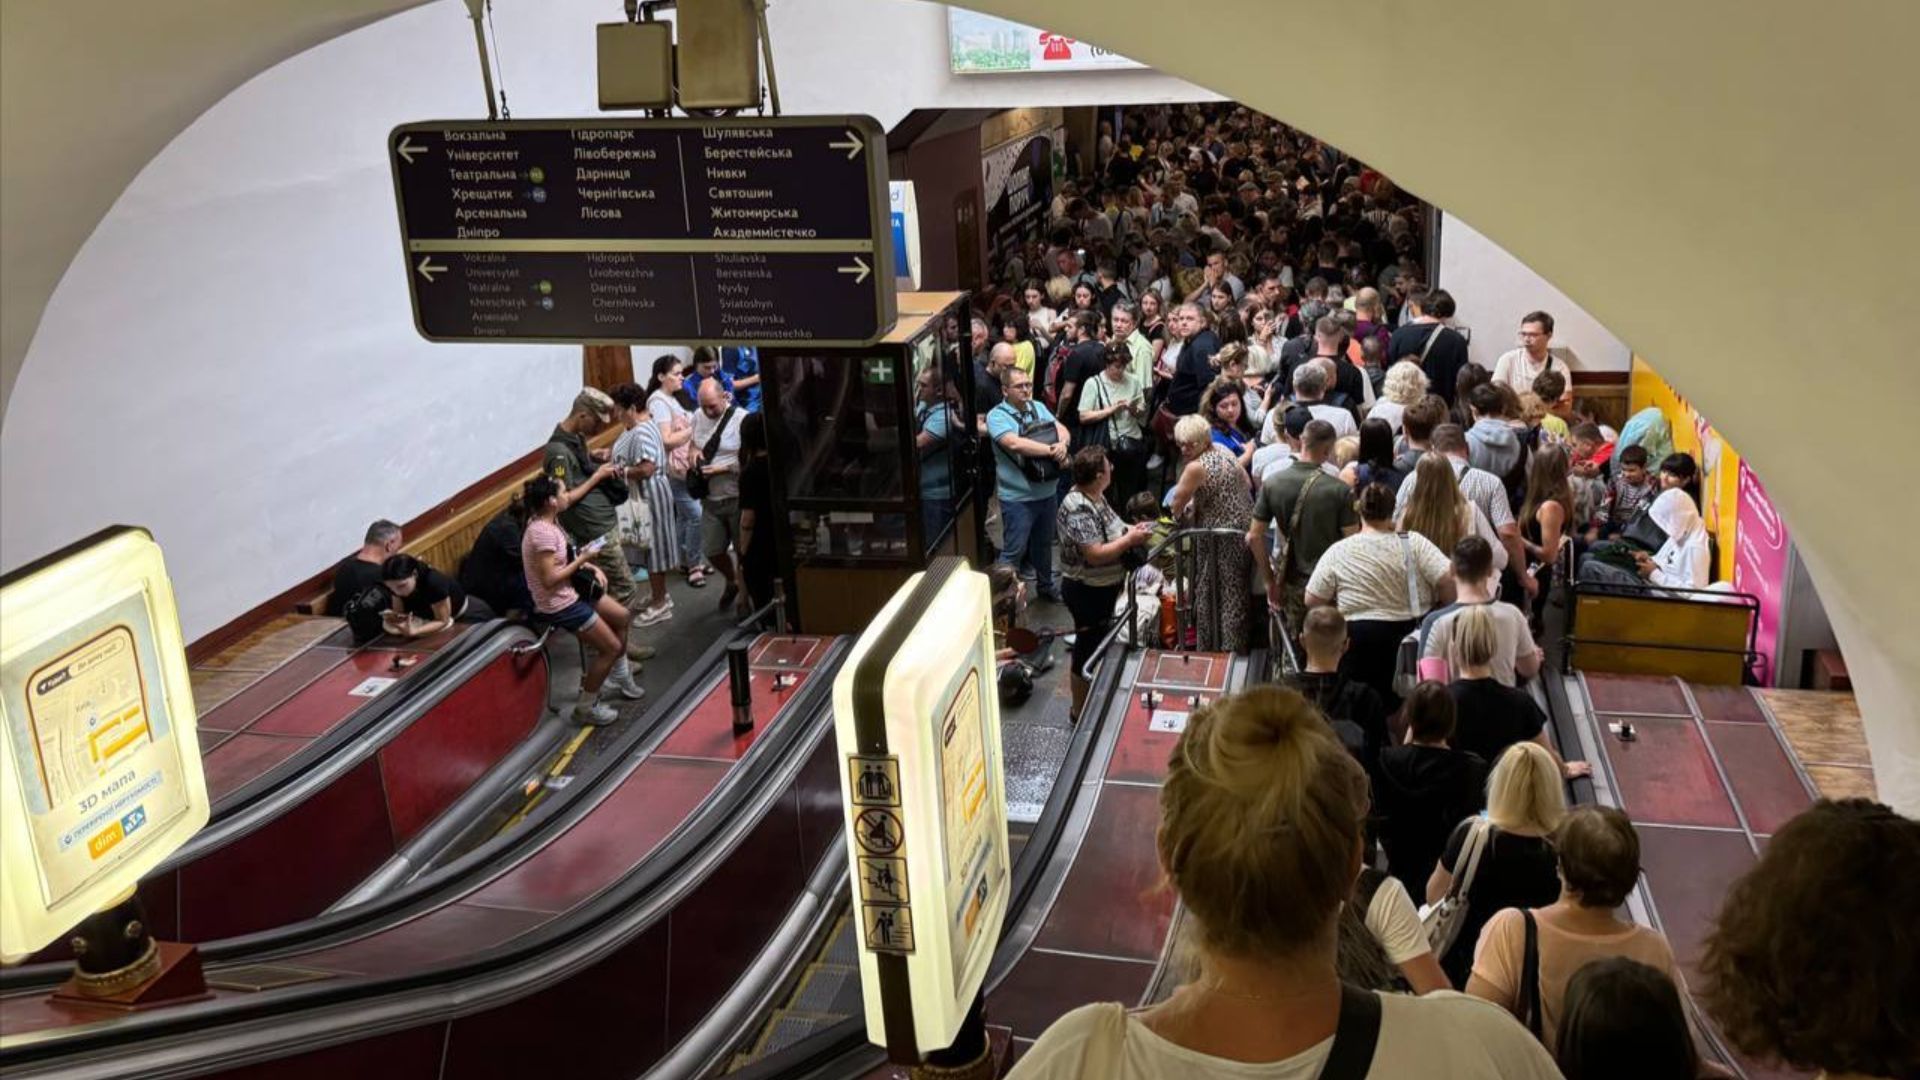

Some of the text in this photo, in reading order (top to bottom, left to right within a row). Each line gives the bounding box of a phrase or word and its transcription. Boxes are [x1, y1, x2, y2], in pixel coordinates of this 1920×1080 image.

[444, 129, 507, 142] Вокзальна
[703, 127, 774, 141] Шулявська
[446, 149, 519, 162] Університет
[574, 147, 656, 162] Лівобережна
[705, 147, 793, 162] Берестейська
[450, 168, 517, 182] Театральна
[576, 167, 631, 182] Дарниця
[707, 167, 747, 179] Нивки
[452, 187, 513, 202] Хрещатик
[578, 186, 656, 202] Чернігівська
[709, 187, 773, 200] Святошин
[455, 207, 527, 220] Арсенальна
[581, 206, 622, 219] Лісова
[711, 206, 798, 221] Житомирська
[457, 226, 500, 239] Дніпро
[713, 226, 817, 239] Академмістечко
[718, 283, 750, 296] Nyvky
[78, 770, 136, 814] 3D мапа
[95, 828, 119, 851] dim
